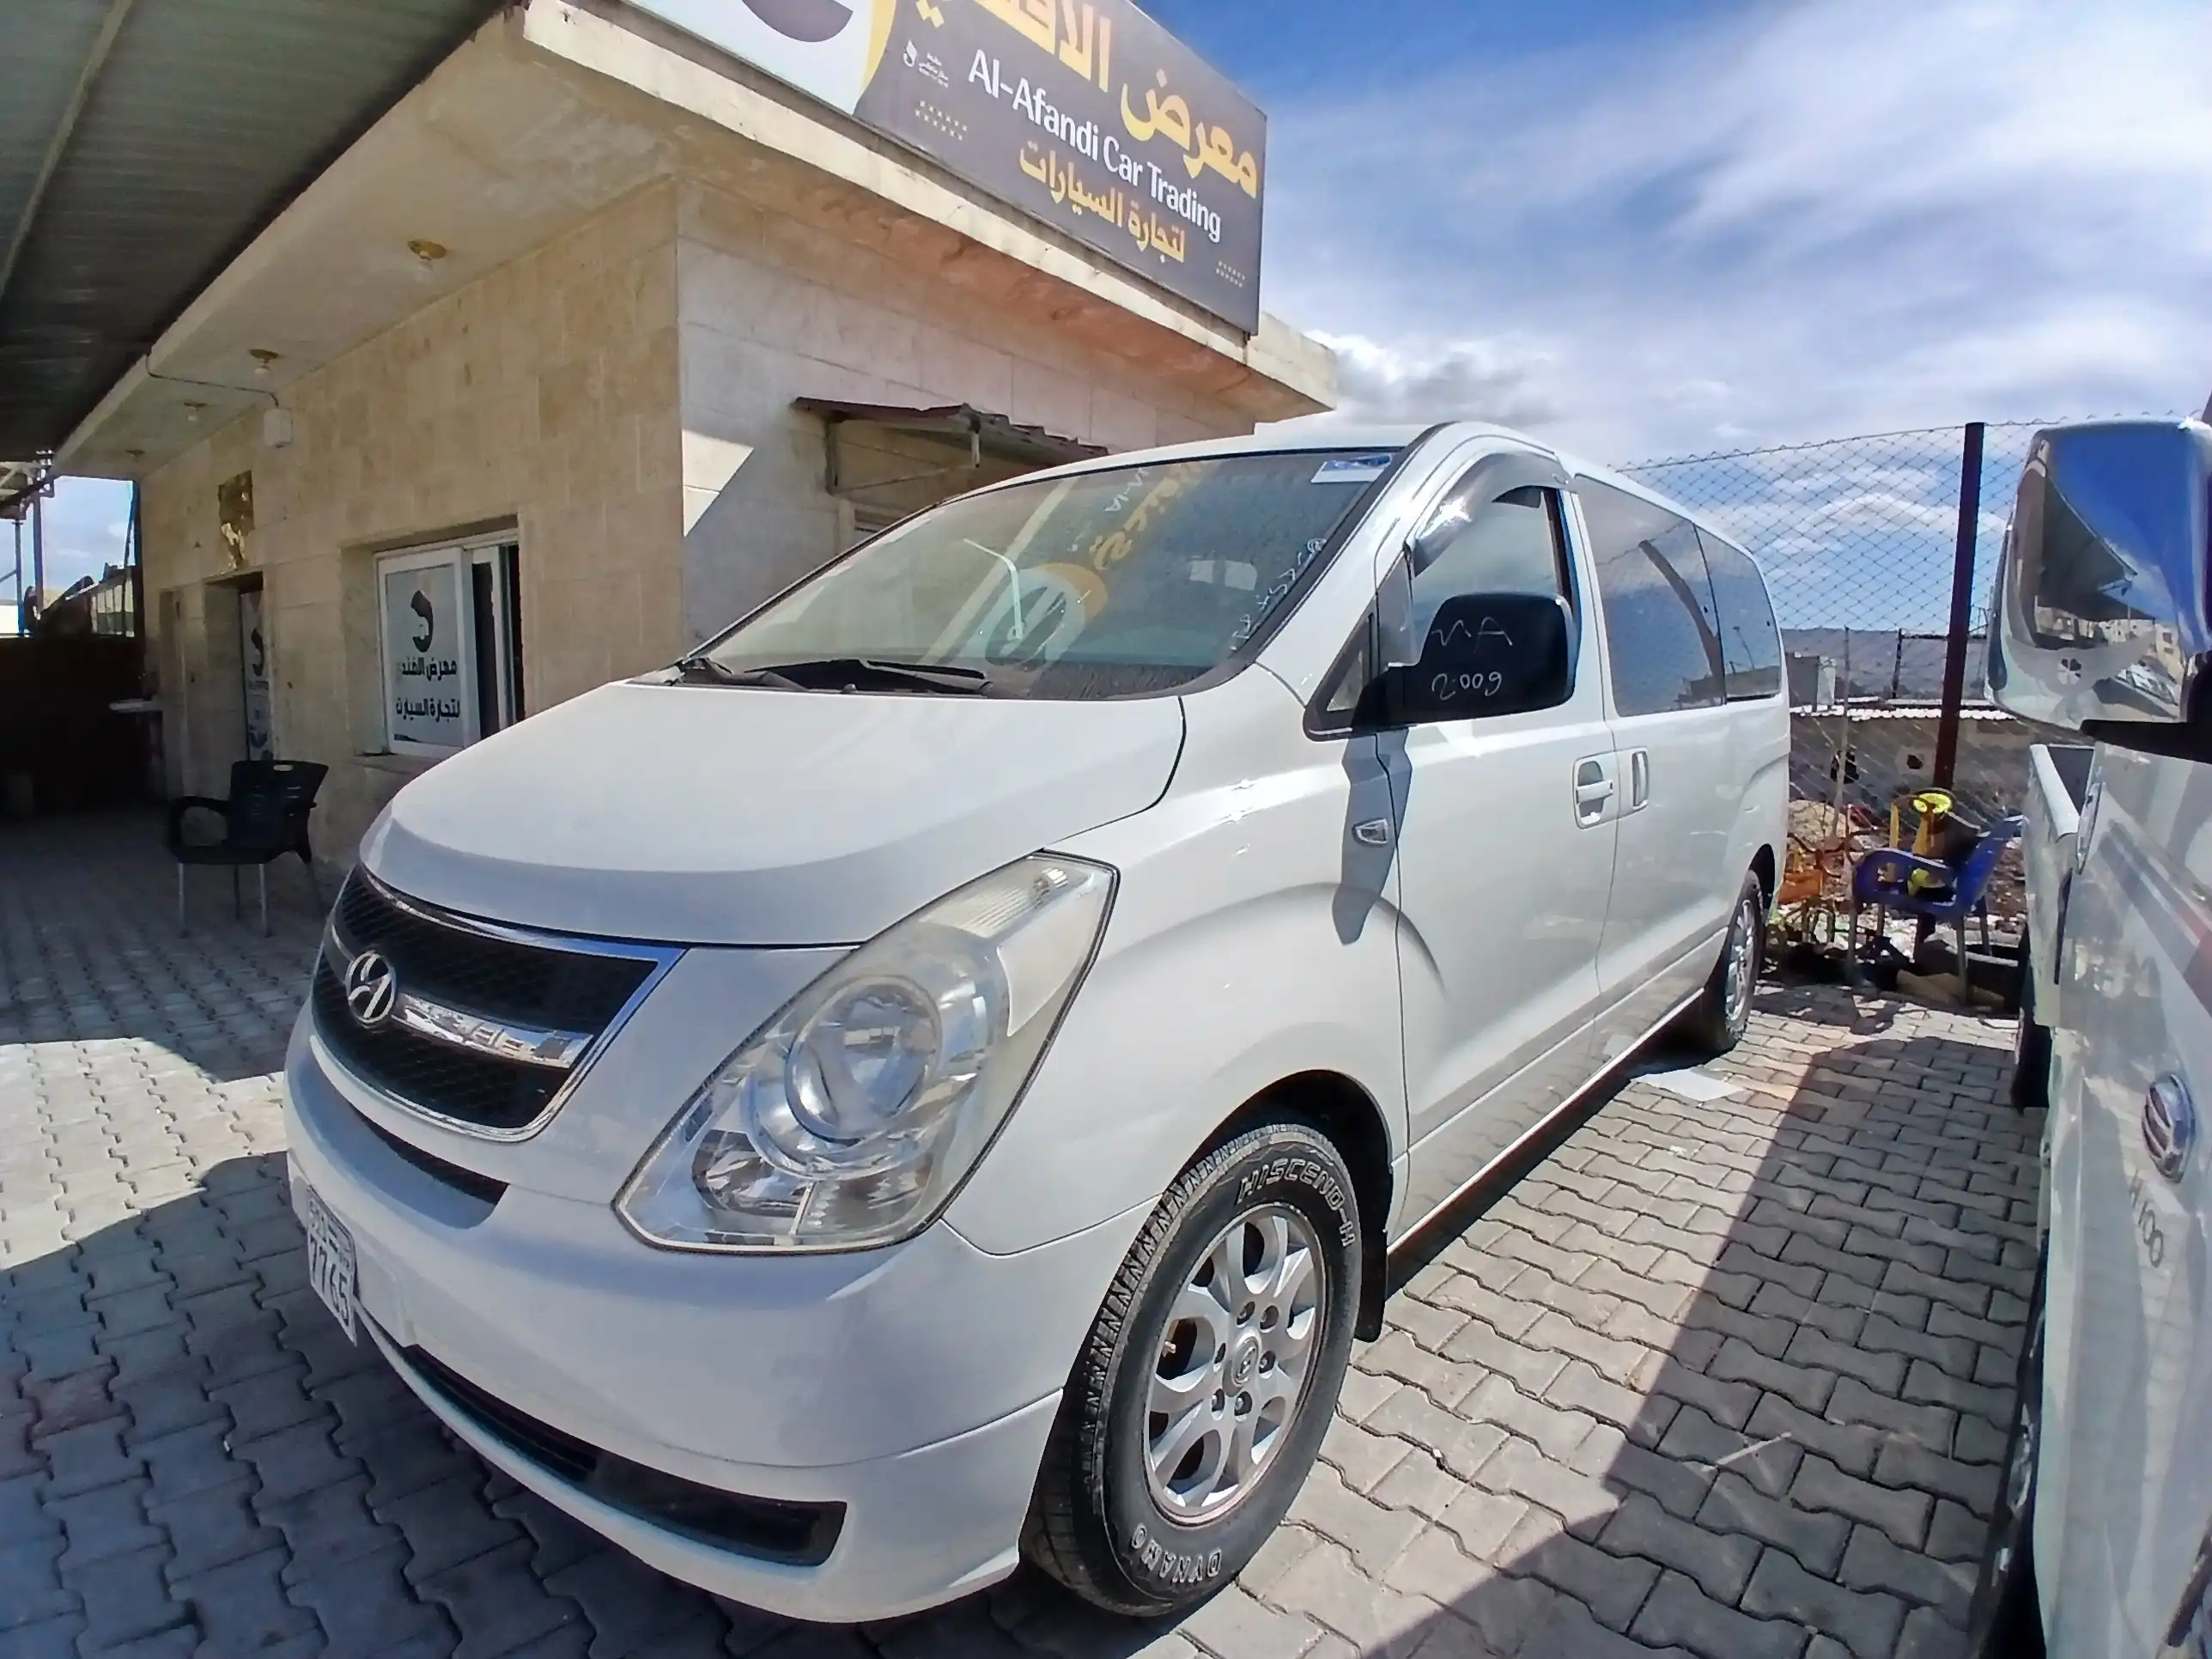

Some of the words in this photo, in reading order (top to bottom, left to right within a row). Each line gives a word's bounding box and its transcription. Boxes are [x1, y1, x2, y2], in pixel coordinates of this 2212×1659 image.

[968, 49, 1099, 161] Al-Afandi
[1103, 136, 1144, 186] Car
[1147, 161, 1220, 243] Trading
[1121, 69, 1257, 198] معرض
[1019, 141, 1122, 228] السيارات
[1127, 200, 1185, 263] لتجارة
[426, 657, 458, 682] معرض
[1431, 672, 1502, 701] 2009
[430, 698, 460, 723] لتجارة
[1236, 1158, 1355, 1247] HISCEND-H
[309, 1233, 349, 1328] 7765
[1132, 1522, 1222, 1583] DYNAMO
